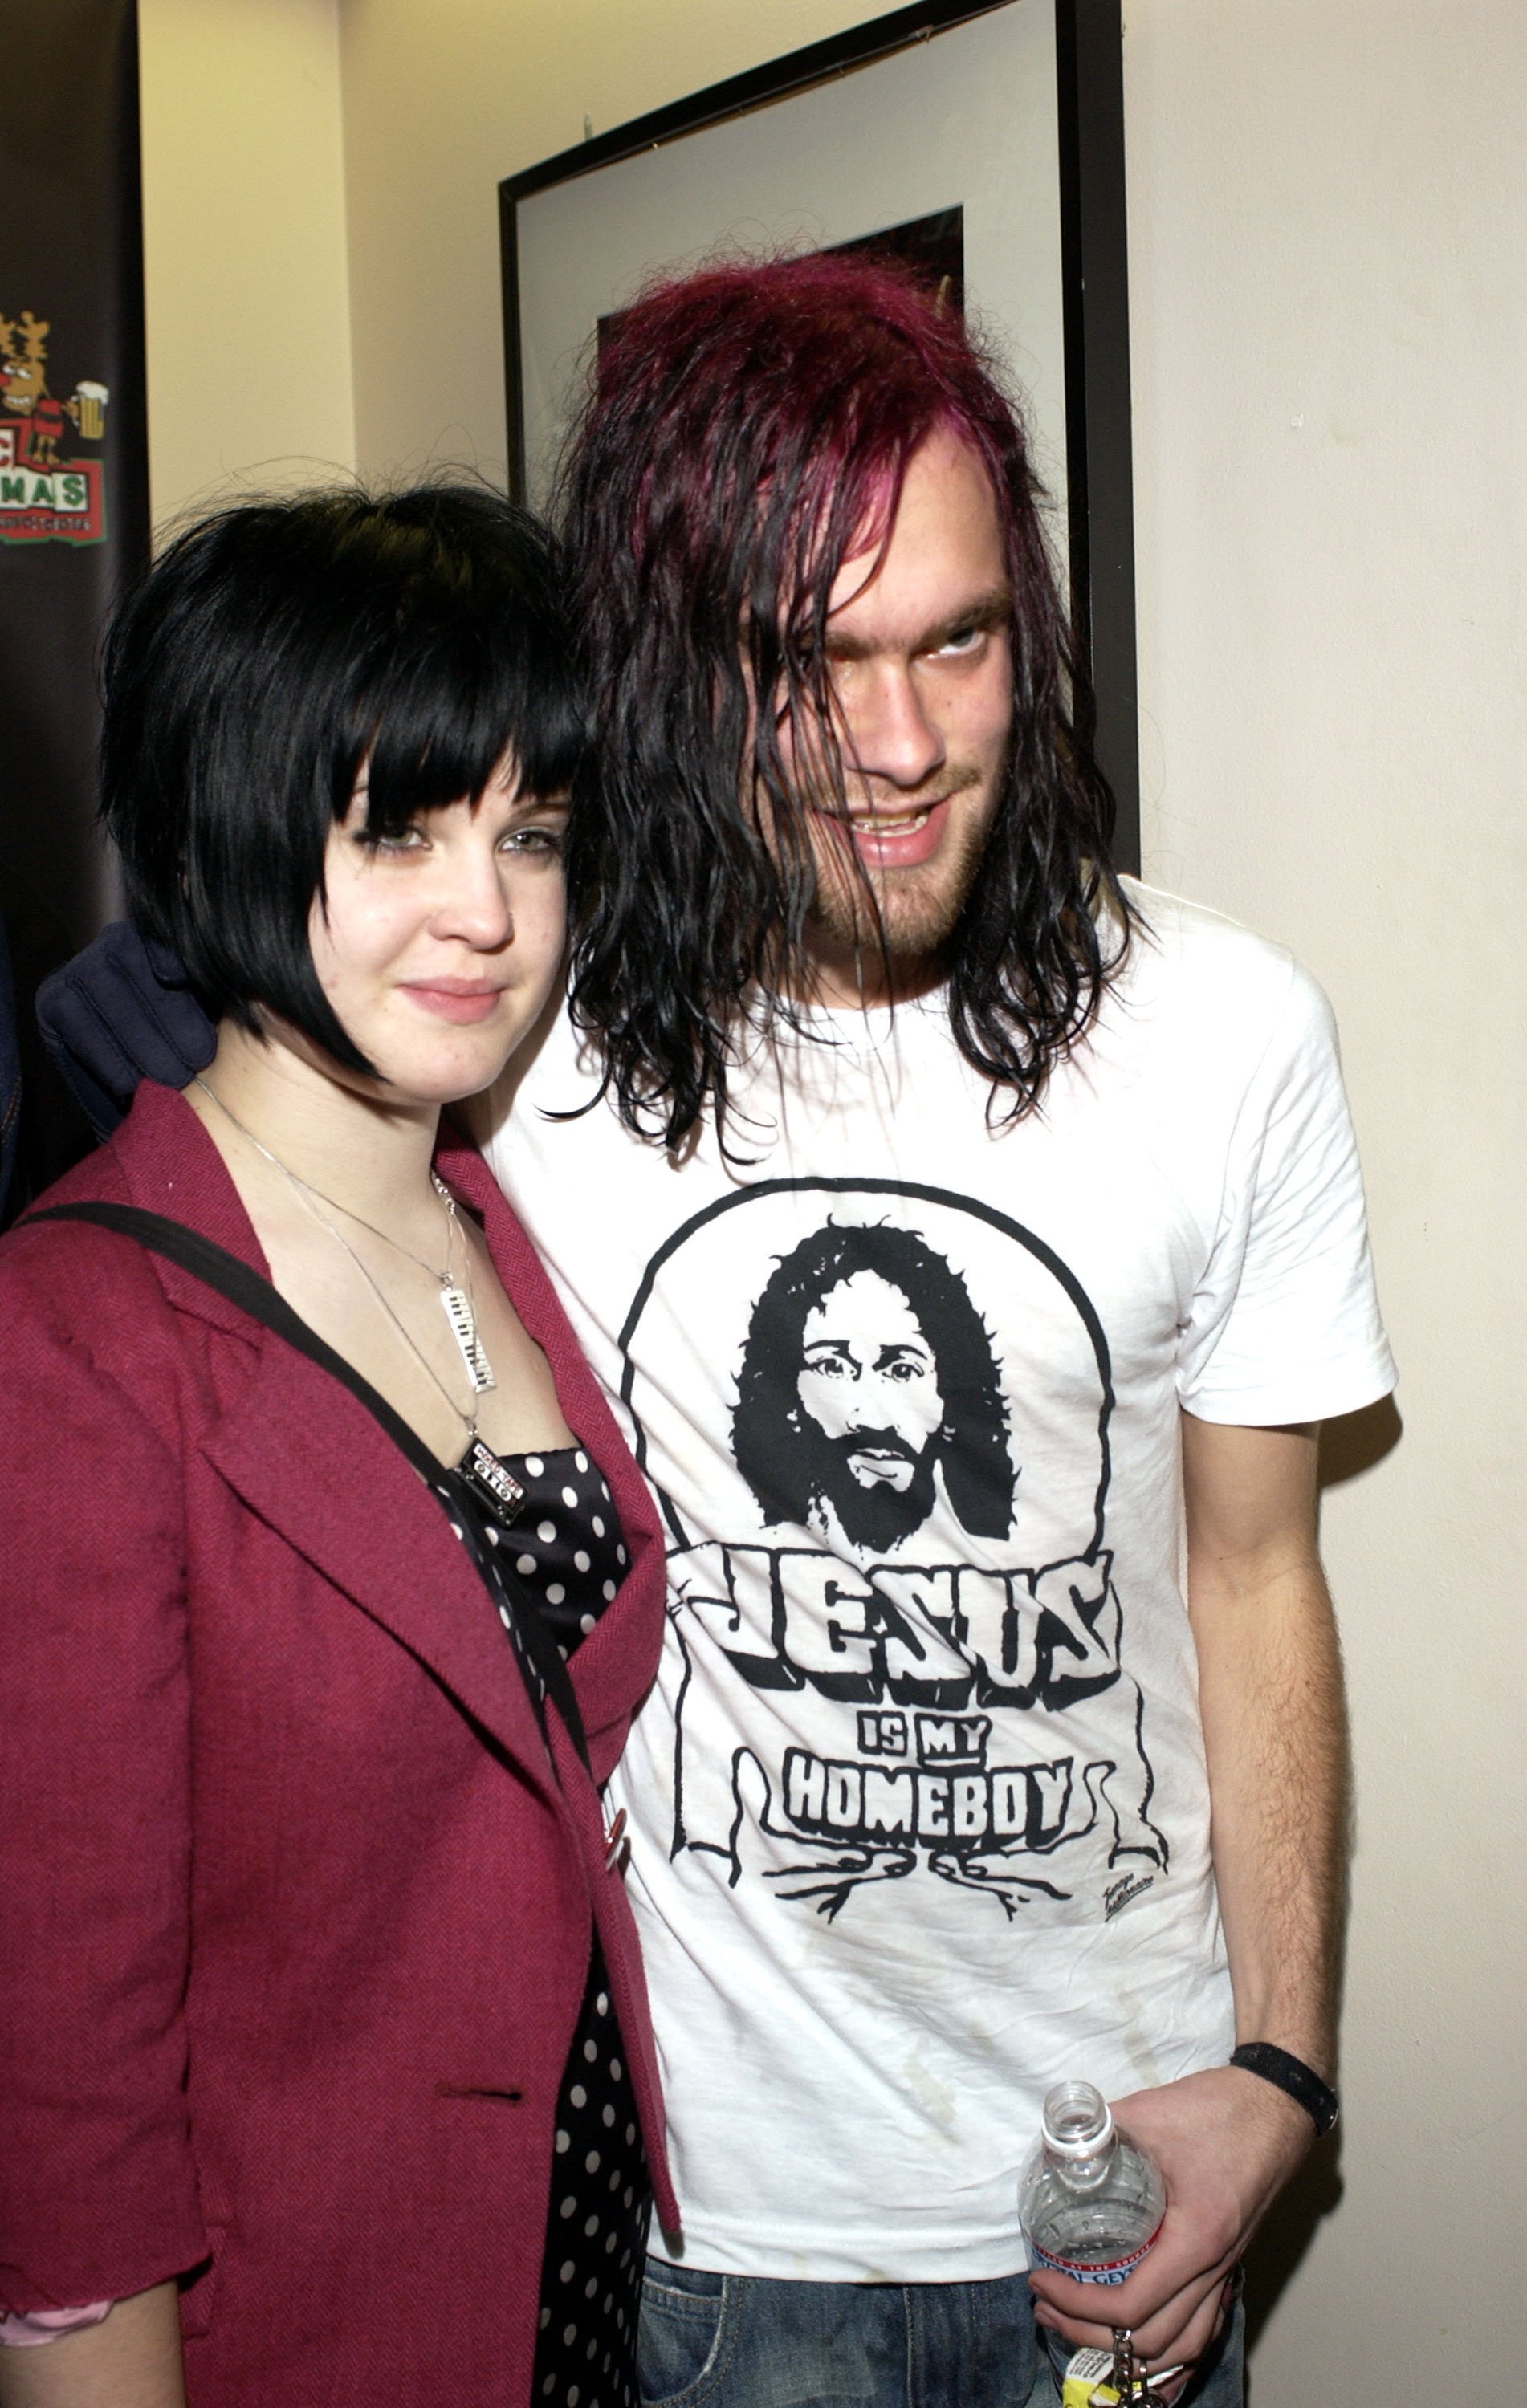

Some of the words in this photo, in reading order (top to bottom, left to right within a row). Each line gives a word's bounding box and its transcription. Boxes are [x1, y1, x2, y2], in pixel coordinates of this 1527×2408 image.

[685, 1542, 1122, 1712] JESUS
[857, 1711, 907, 1755] IS
[914, 1713, 992, 1762] MY
[783, 1747, 1073, 1848] HOMEBOY
